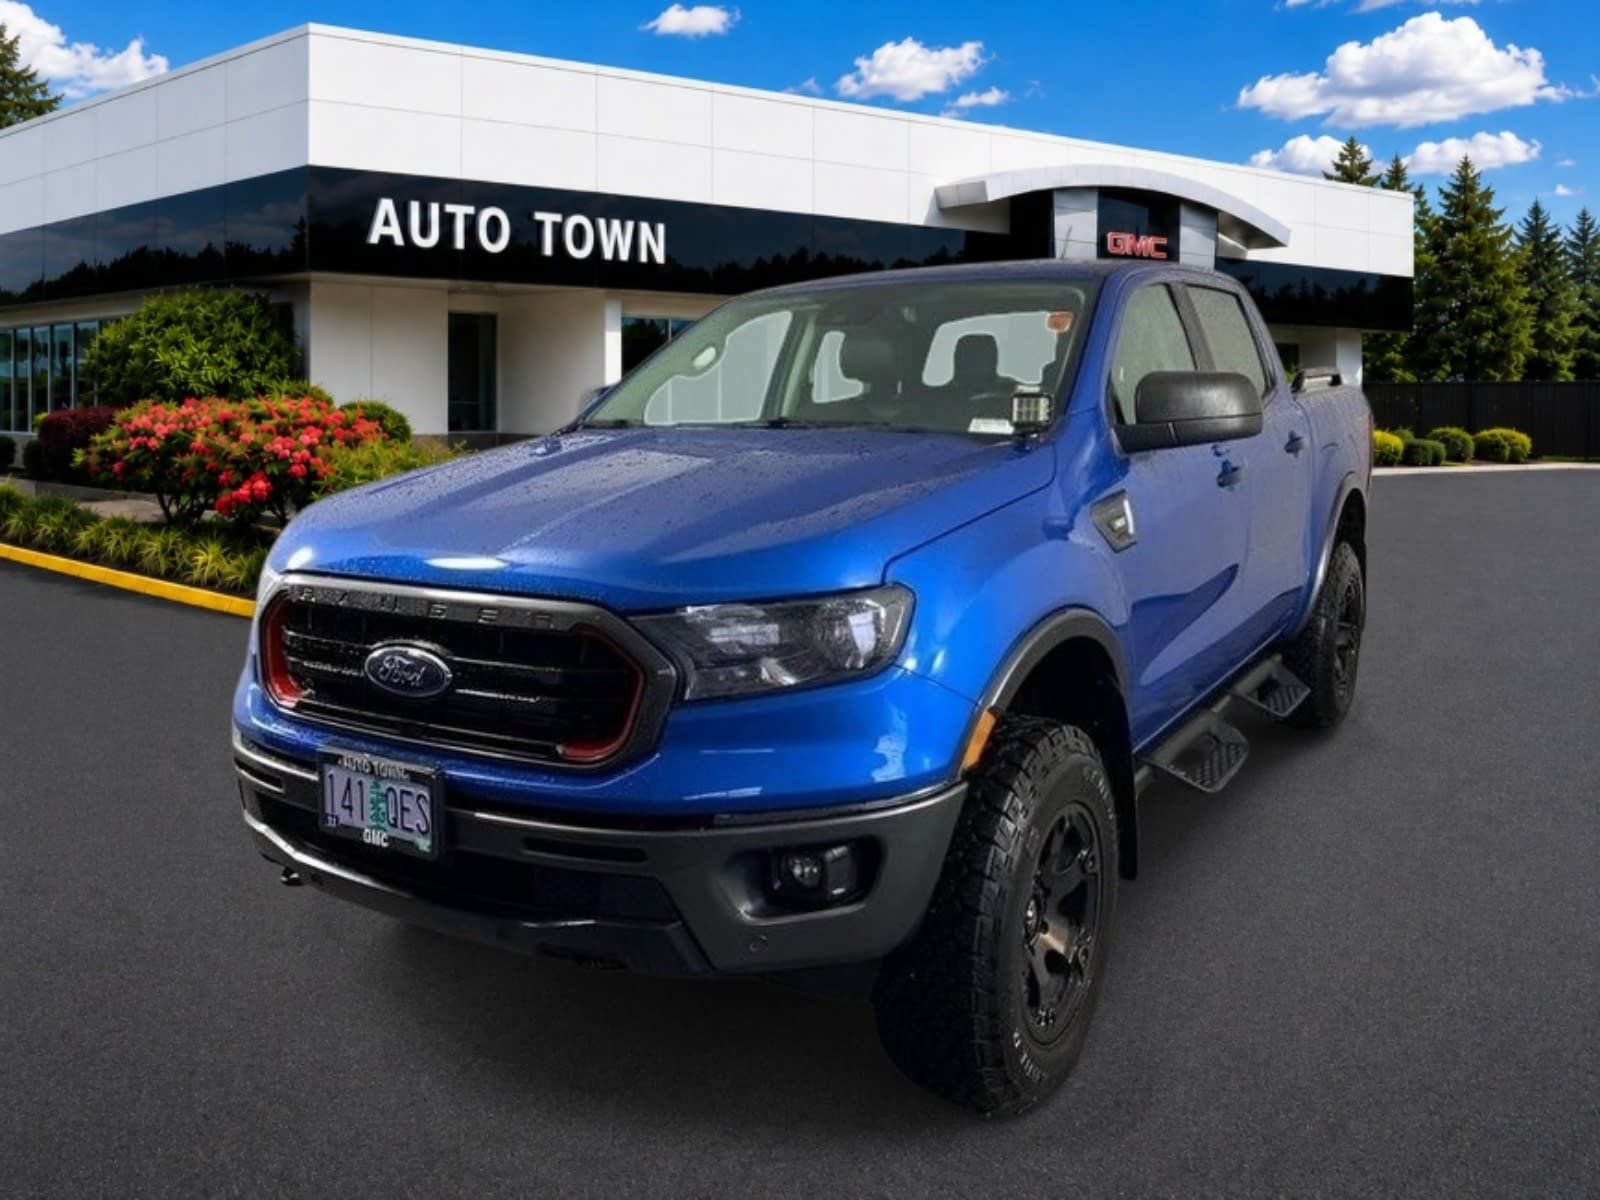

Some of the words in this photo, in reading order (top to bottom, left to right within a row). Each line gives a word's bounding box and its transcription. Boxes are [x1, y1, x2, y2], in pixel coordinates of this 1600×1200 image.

[367, 198, 511, 253] AUTO
[533, 211, 666, 265] TOWN
[1107, 231, 1168, 259] GMC
[378, 655, 426, 687] Ford
[327, 773, 364, 822] 141
[385, 786, 430, 835] QES
[362, 827, 390, 848] GMC
